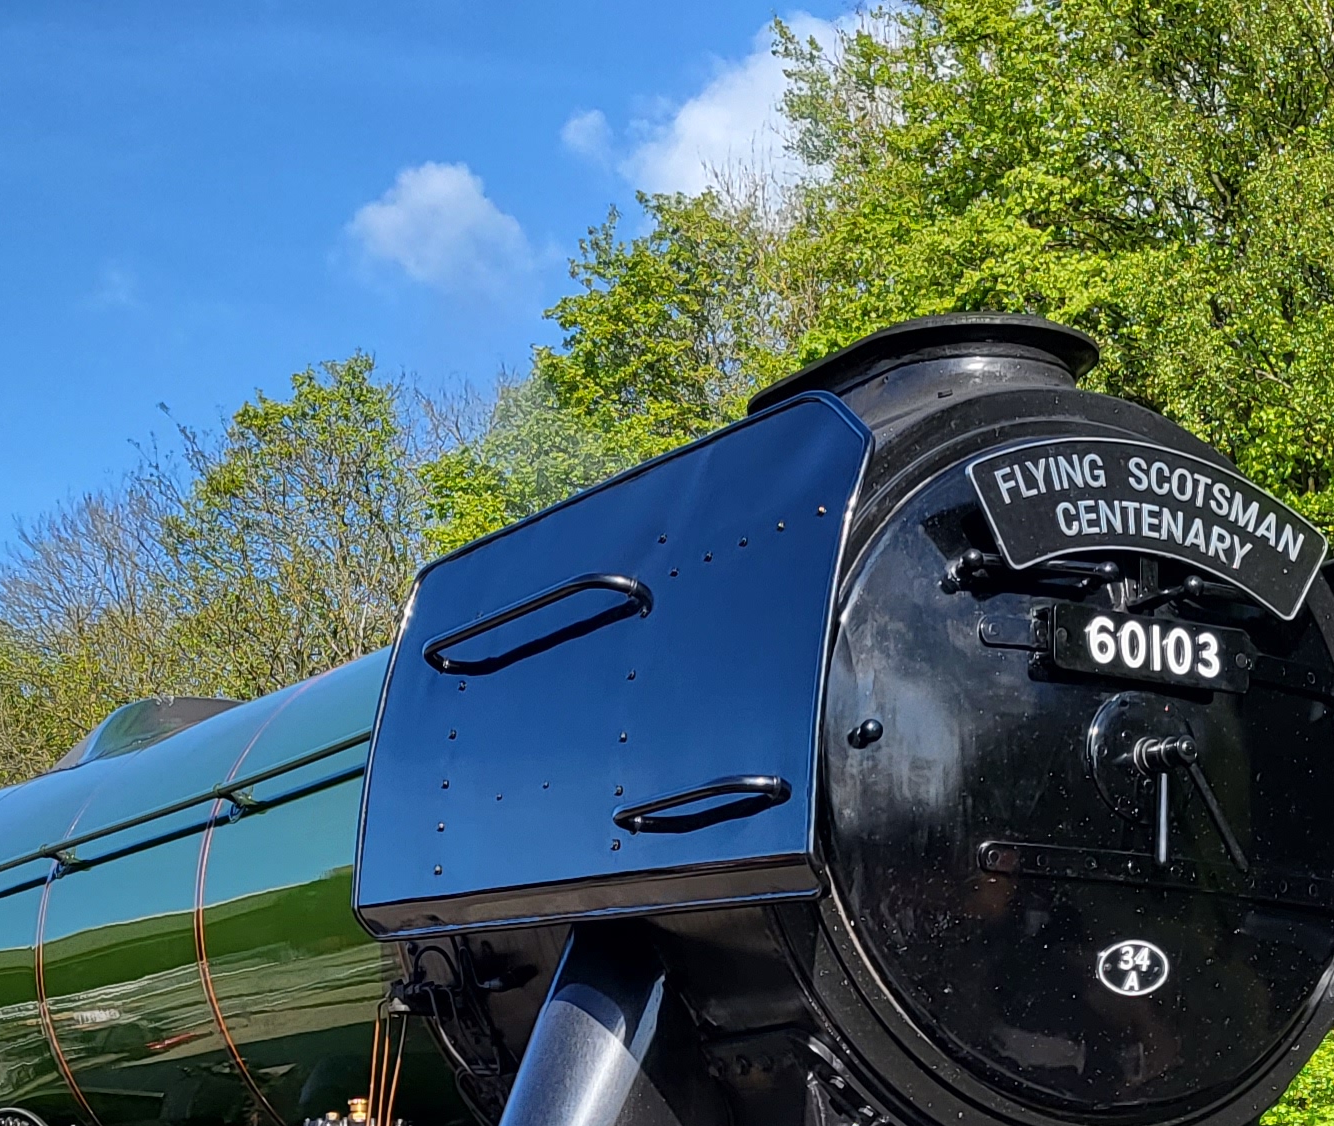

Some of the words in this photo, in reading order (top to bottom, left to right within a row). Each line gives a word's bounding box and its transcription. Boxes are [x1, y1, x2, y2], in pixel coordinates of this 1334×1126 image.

[993, 453, 1106, 504] FLYING
[1128, 456, 1305, 563] SCOTSMAN
[1056, 500, 1253, 570] CENTENARY
[1086, 615, 1220, 678] 60103
[1120, 945, 1151, 972] 34
[1123, 970, 1139, 991] A
